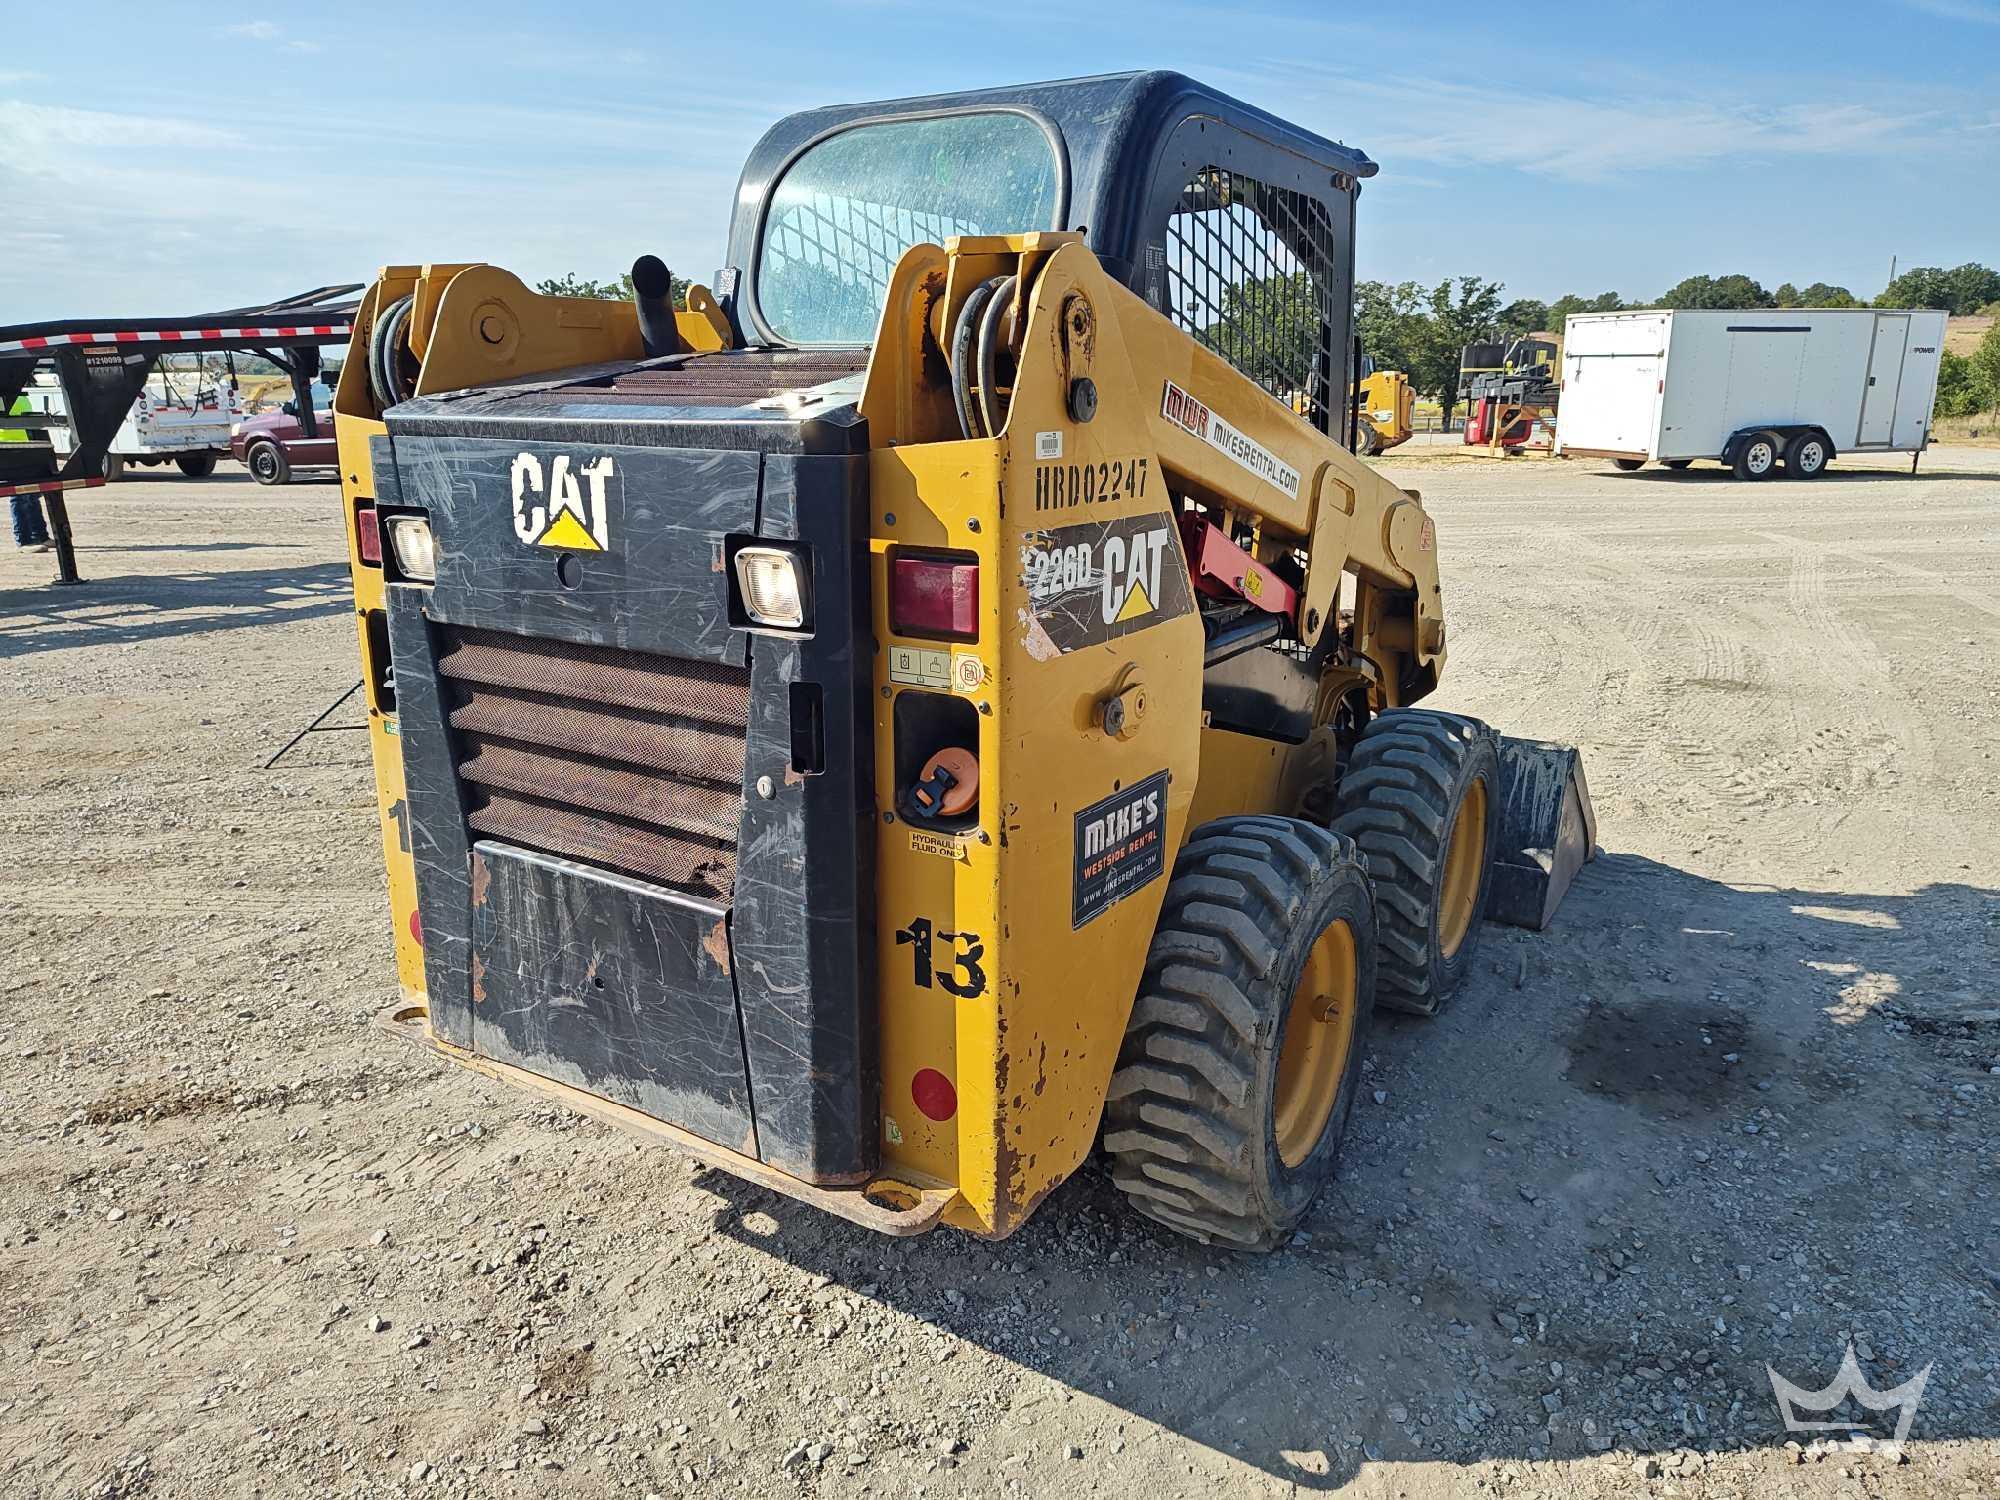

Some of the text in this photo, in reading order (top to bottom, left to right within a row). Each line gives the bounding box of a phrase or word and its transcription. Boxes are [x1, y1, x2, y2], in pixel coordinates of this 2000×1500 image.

[1165, 383, 1210, 441] MWR
[510, 452, 614, 552] CAT
[1034, 528, 1168, 625] 226D CAT
[911, 842, 937, 854] FLUID
[912, 833, 962, 851] HYDRAULIC
[1084, 790, 1158, 860] MIKE'S
[1083, 849, 1126, 881] WESTSIDE
[895, 917, 988, 999] 13
